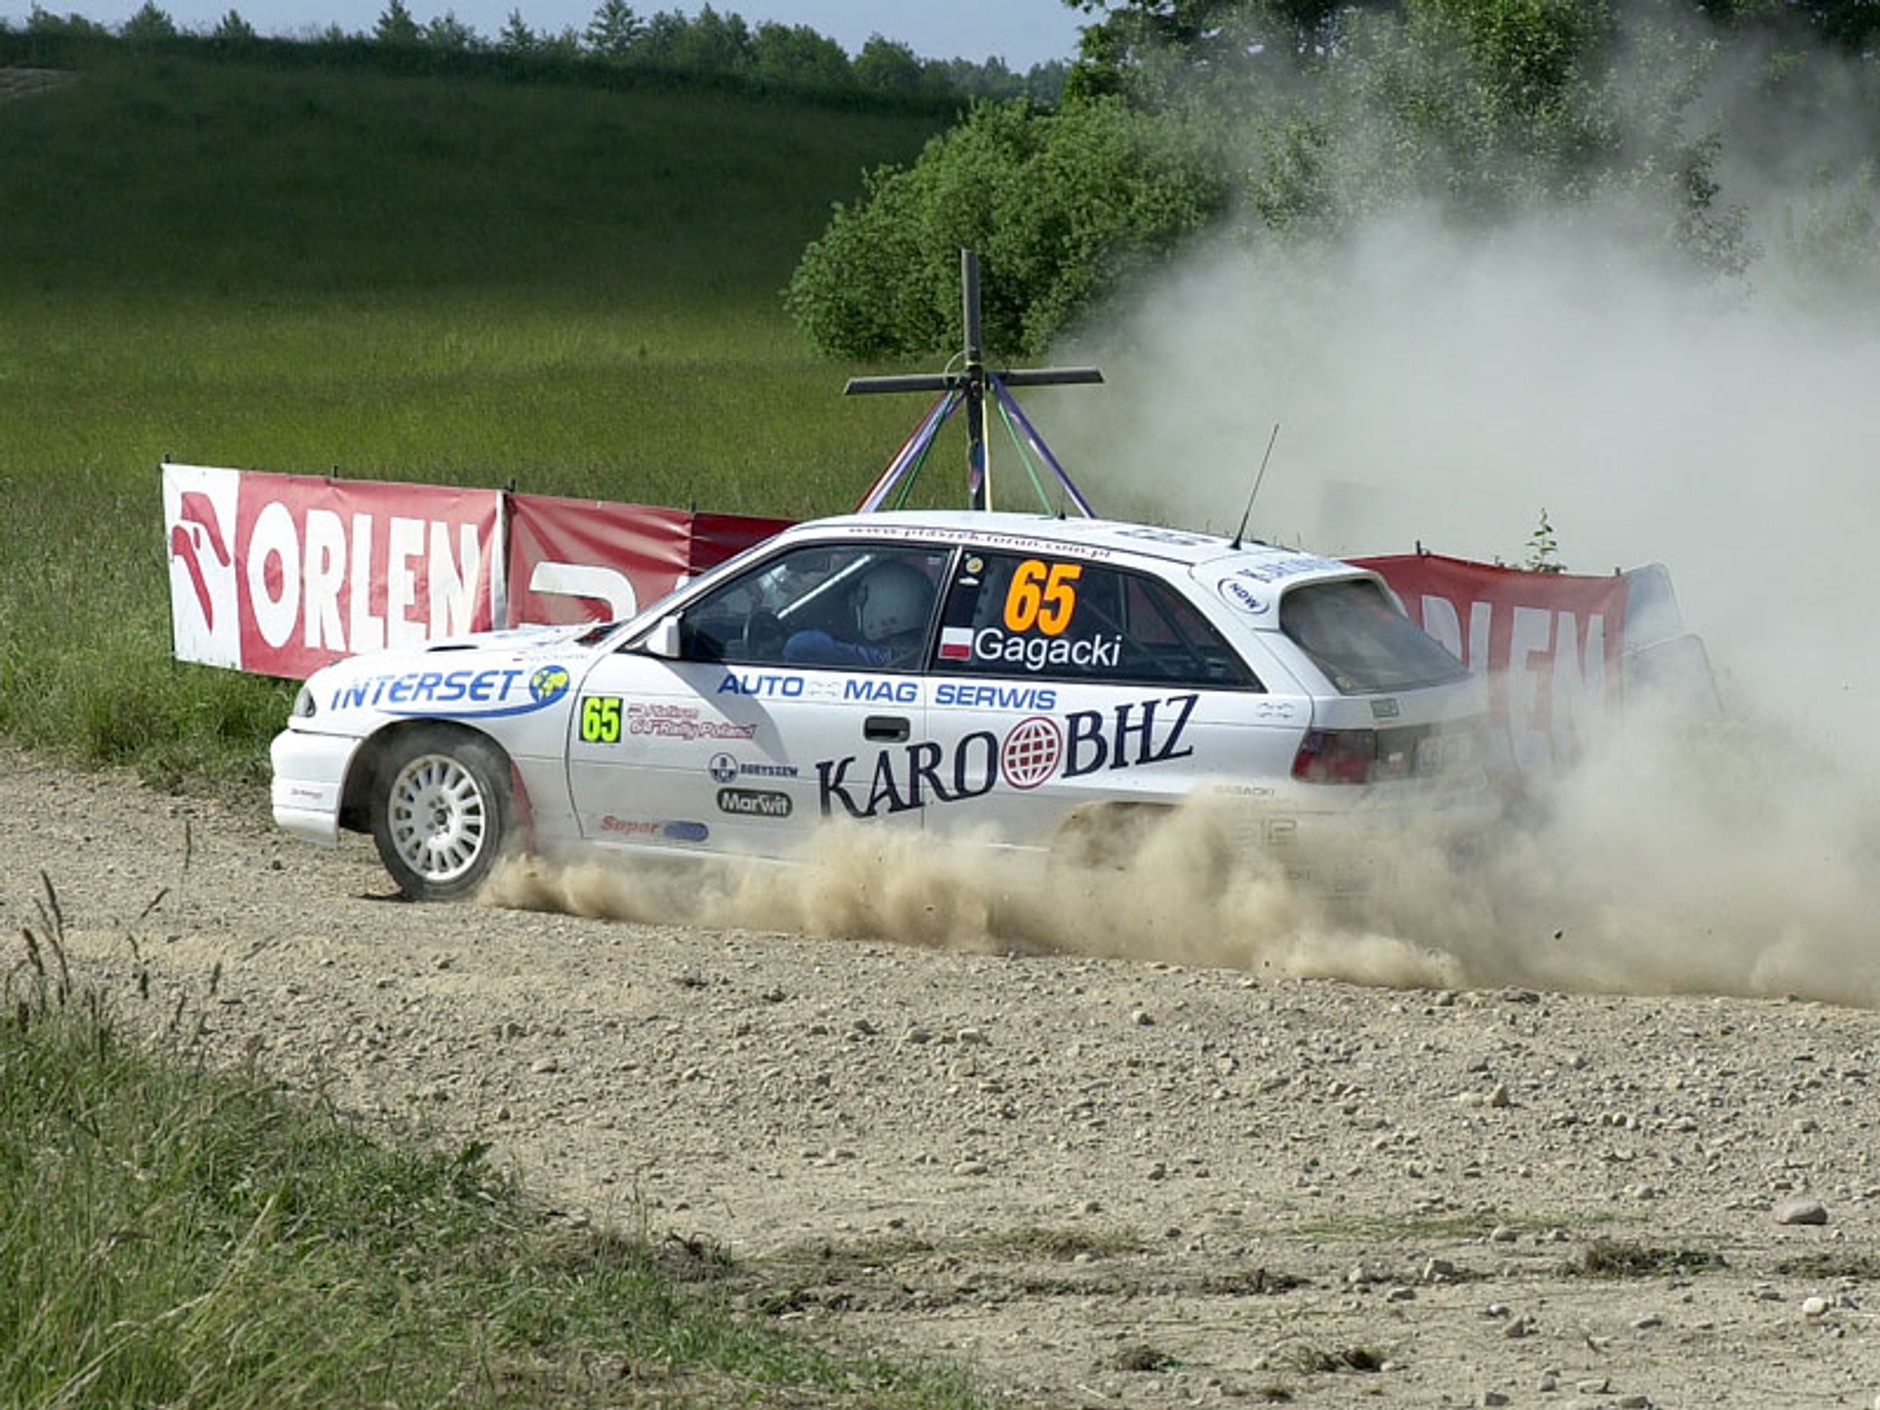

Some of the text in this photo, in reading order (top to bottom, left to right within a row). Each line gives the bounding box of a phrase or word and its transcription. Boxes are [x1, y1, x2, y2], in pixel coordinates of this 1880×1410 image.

[246, 501, 481, 653] ORLEN
[1003, 559, 1083, 637] 65
[973, 627, 1123, 671] Gagacki
[330, 670, 524, 711] INTERSET
[716, 673, 1057, 711] AUTO MAG SERWIS
[582, 697, 621, 742] 65
[815, 693, 1200, 820] KARO BHZ
